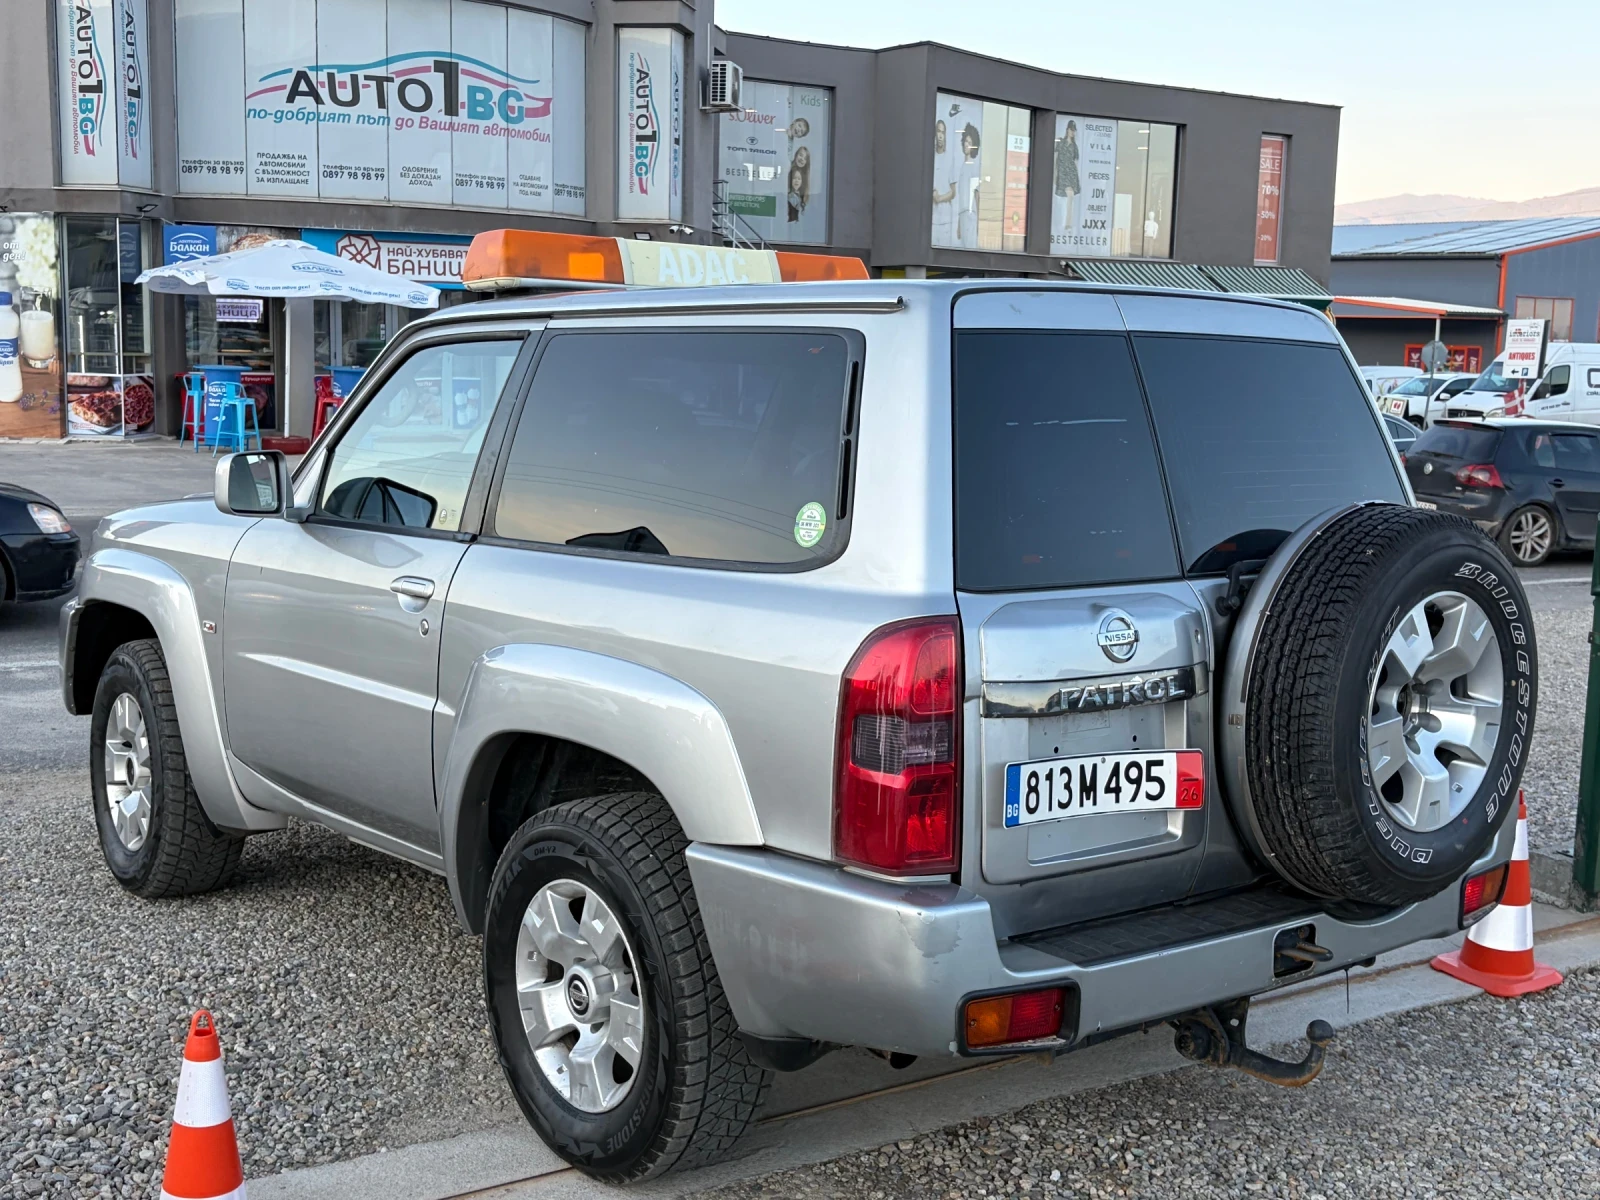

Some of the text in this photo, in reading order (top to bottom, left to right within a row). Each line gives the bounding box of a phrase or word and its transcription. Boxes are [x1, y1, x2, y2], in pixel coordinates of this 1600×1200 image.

[800, 93, 821, 107] Kids
[247, 107, 551, 143] по-добрият път до Вашият автомобил
[1085, 124, 1113, 133] SELECTED
[1090, 143, 1112, 151] VILA
[256, 152, 296, 160] ПРОДАЖБА
[259, 161, 306, 169] АВТОМОБИЛИ
[1260, 157, 1280, 170] SALE
[181, 165, 245, 175] 0897 98 98 99
[262, 169, 310, 177] ВЪЗМОЖНОСТ
[322, 170, 385, 181] 0897 98 98 99
[401, 166, 438, 174] ОДОБРЕНИЕ
[267, 177, 310, 185] ИЗПЛАЩАНЕ
[1088, 171, 1110, 181] PIECES
[408, 179, 433, 187] ДОХОД
[455, 178, 505, 190] 0897 98 98 99
[1091, 188, 1106, 199] JDY
[1081, 219, 1107, 230] JJXX
[1050, 234, 1107, 246] BESTSELLER
[169, 242, 210, 253] Балкан
[387, 245, 468, 259] НАЙ-ХУБАВАТ
[2, 252, 26, 262] ден!
[387, 259, 464, 280] БАНИЦ
[657, 246, 749, 286] ADAC
[1508, 351, 1536, 362] ANTIQUES
[1104, 630, 1137, 643] NISSAN
[1059, 674, 1187, 710] PATROL
[1455, 562, 1531, 824] BRIDGESTONE
[1181, 787, 1199, 802] 26
[1006, 803, 1019, 818] BG
[534, 845, 557, 856] DM-V2
